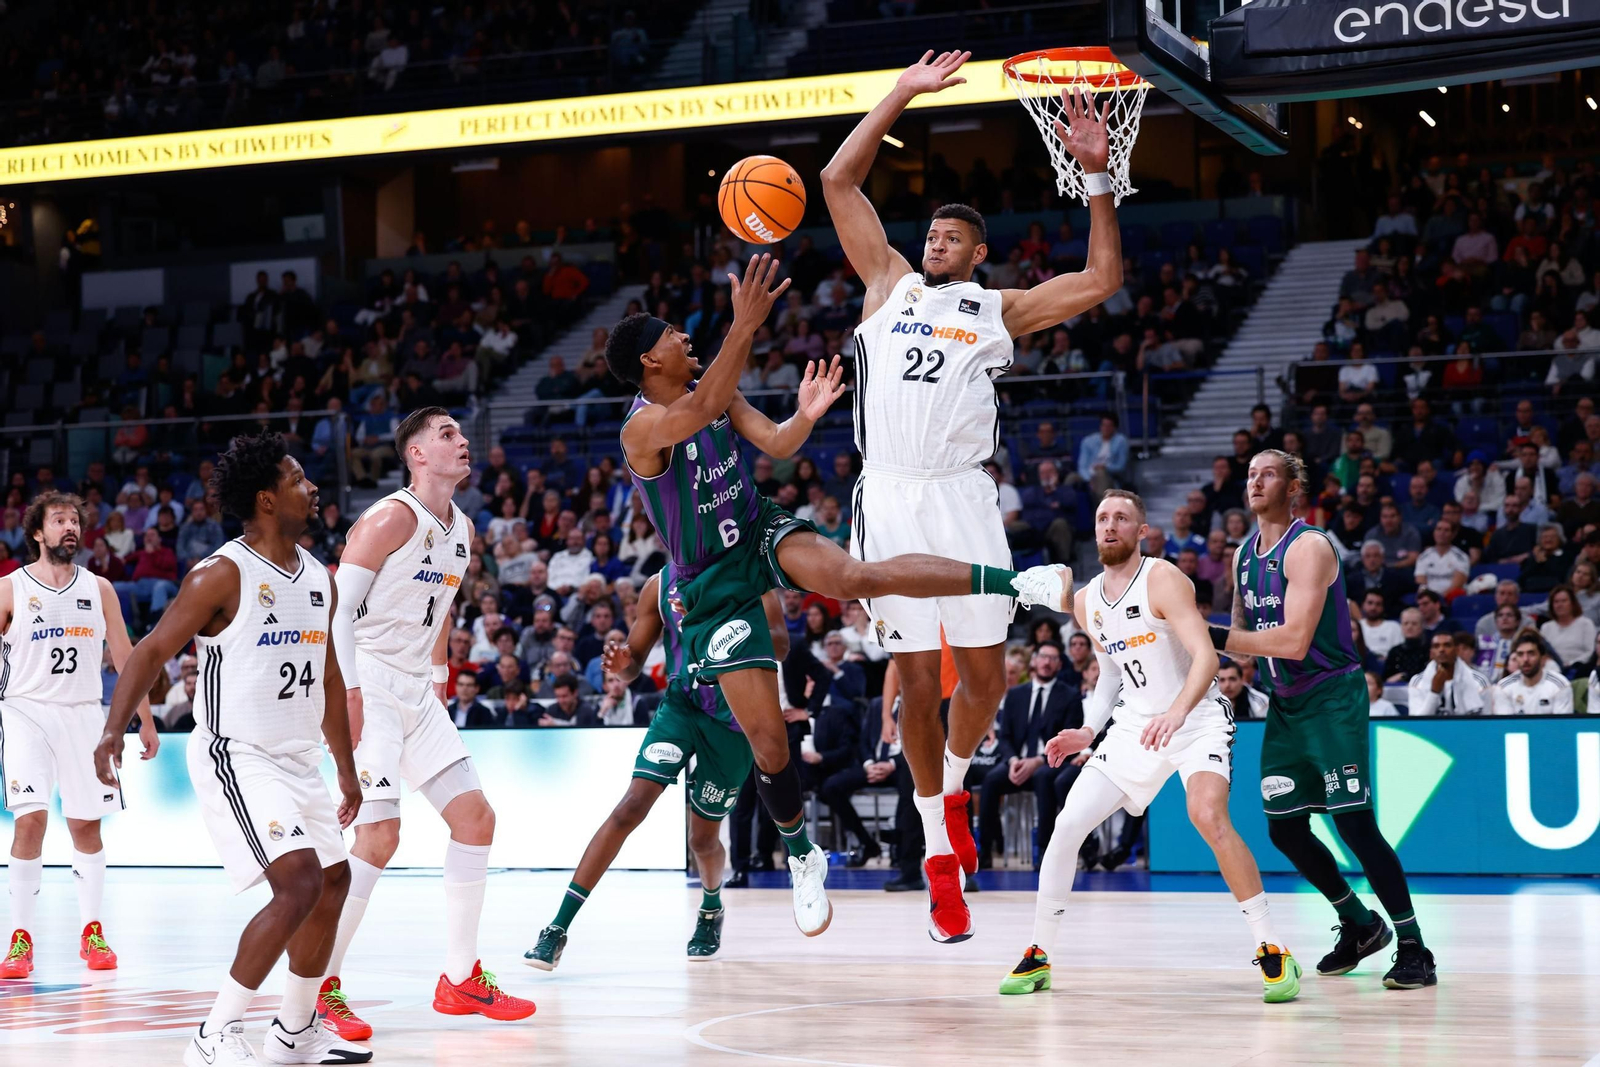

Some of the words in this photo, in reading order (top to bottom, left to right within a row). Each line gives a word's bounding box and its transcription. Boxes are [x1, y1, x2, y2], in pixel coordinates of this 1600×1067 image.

[460, 112, 552, 136] PERFECT
[562, 102, 673, 126] MOMENTS
[680, 98, 705, 118] BY
[714, 86, 854, 112] SCHWEPPES
[3, 153, 67, 174] RFECT
[73, 147, 173, 168] MOMENTS
[178, 143, 200, 160] BY
[208, 133, 331, 156] SCHWEPPES
[891, 321, 978, 345] AUTOHERO
[902, 347, 945, 384] 22
[698, 479, 743, 514] málaga
[718, 518, 740, 548] 6
[412, 569, 461, 589] AUTOHER
[31, 627, 94, 642] AUTOHERO
[711, 620, 749, 658] famadesa
[1104, 632, 1157, 655] UTOHERO
[50, 646, 78, 675] 23
[1123, 659, 1147, 689] 13
[277, 660, 316, 700] 24
[1504, 732, 1600, 850] U
